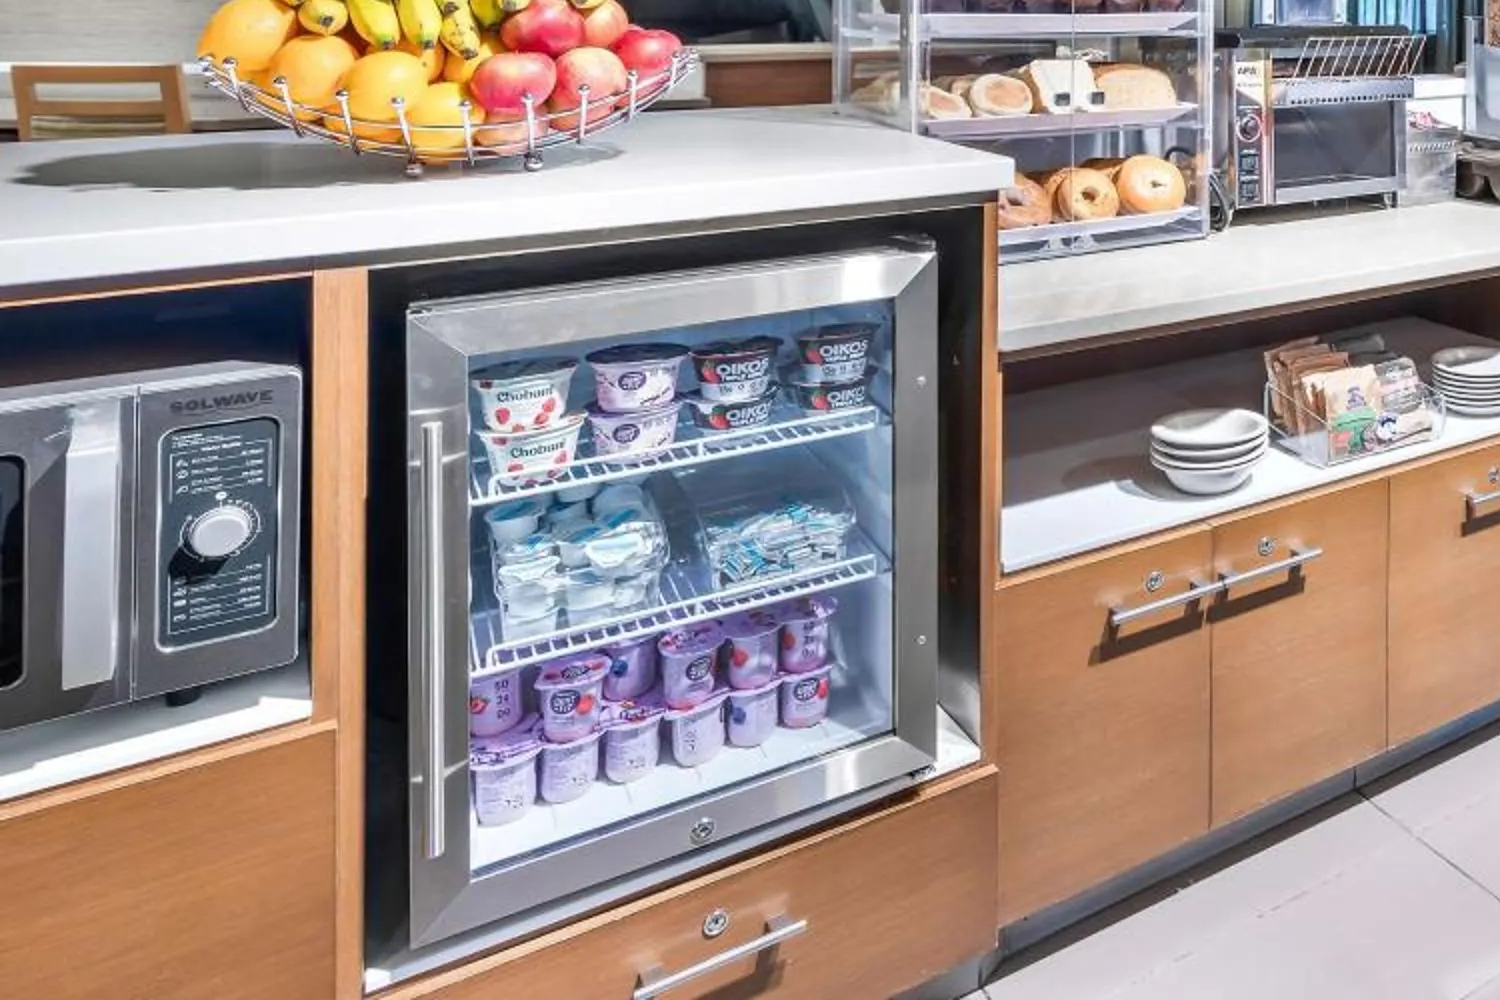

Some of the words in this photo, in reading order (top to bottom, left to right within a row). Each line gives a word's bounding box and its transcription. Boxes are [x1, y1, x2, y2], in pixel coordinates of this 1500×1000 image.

[820, 339, 868, 357] OIKOS
[716, 357, 769, 375] OIKOS
[170, 389, 273, 412] SOLWAVE
[497, 383, 555, 402] Chobani
[510, 438, 567, 459] Chobani
